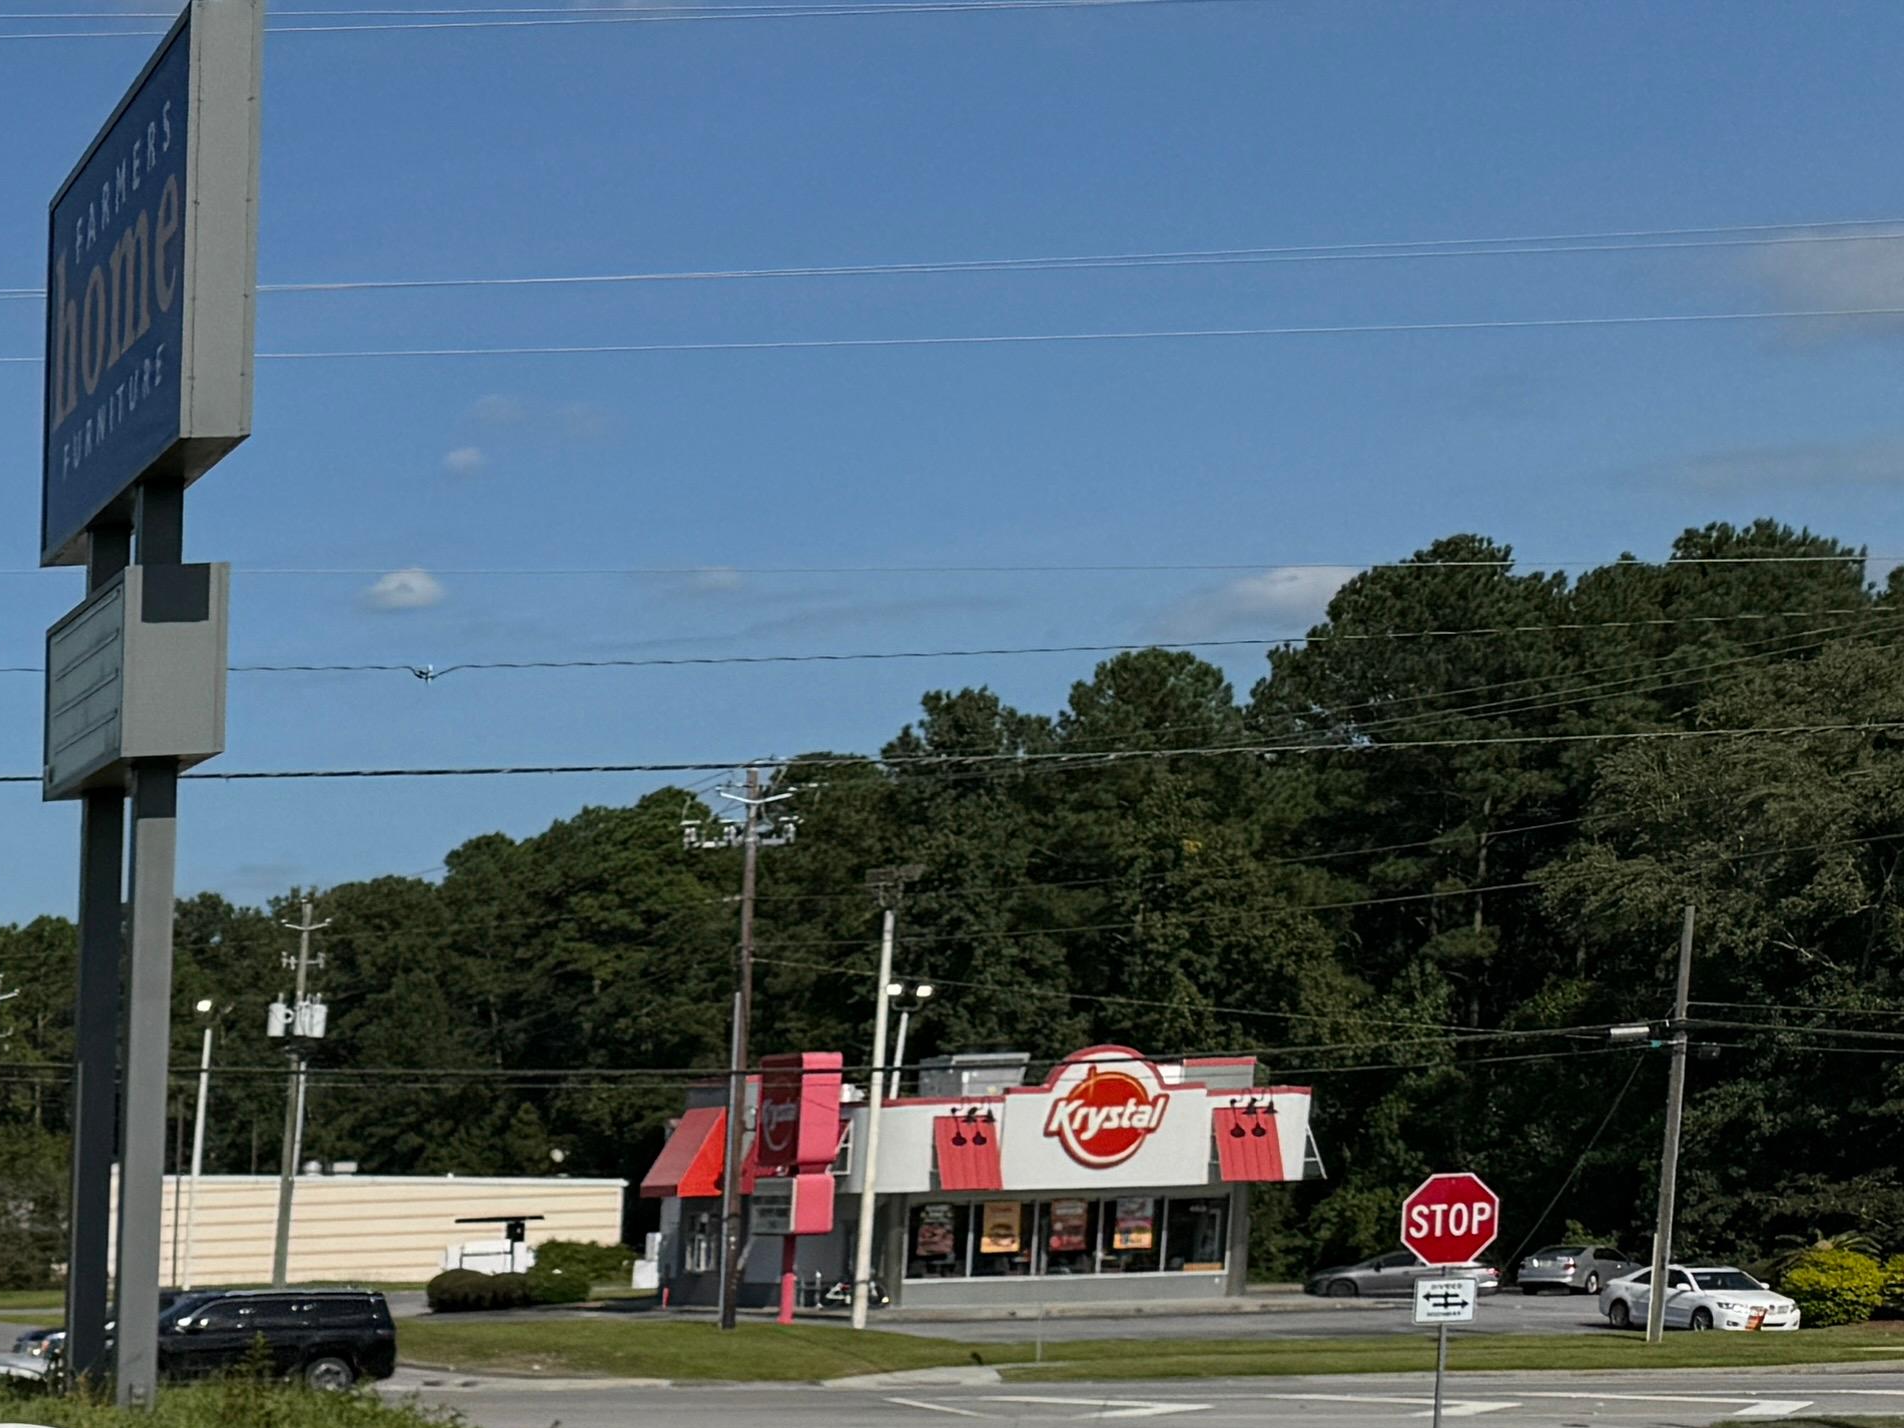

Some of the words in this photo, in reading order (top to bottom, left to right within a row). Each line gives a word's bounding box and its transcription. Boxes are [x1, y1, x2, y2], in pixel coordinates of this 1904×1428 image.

[75, 100, 172, 264] FARMERS
[53, 173, 179, 432] home
[61, 342, 167, 482] FURNITURE
[1046, 1096, 1168, 1141] Krystal
[1408, 1202, 1492, 1239] STOP
